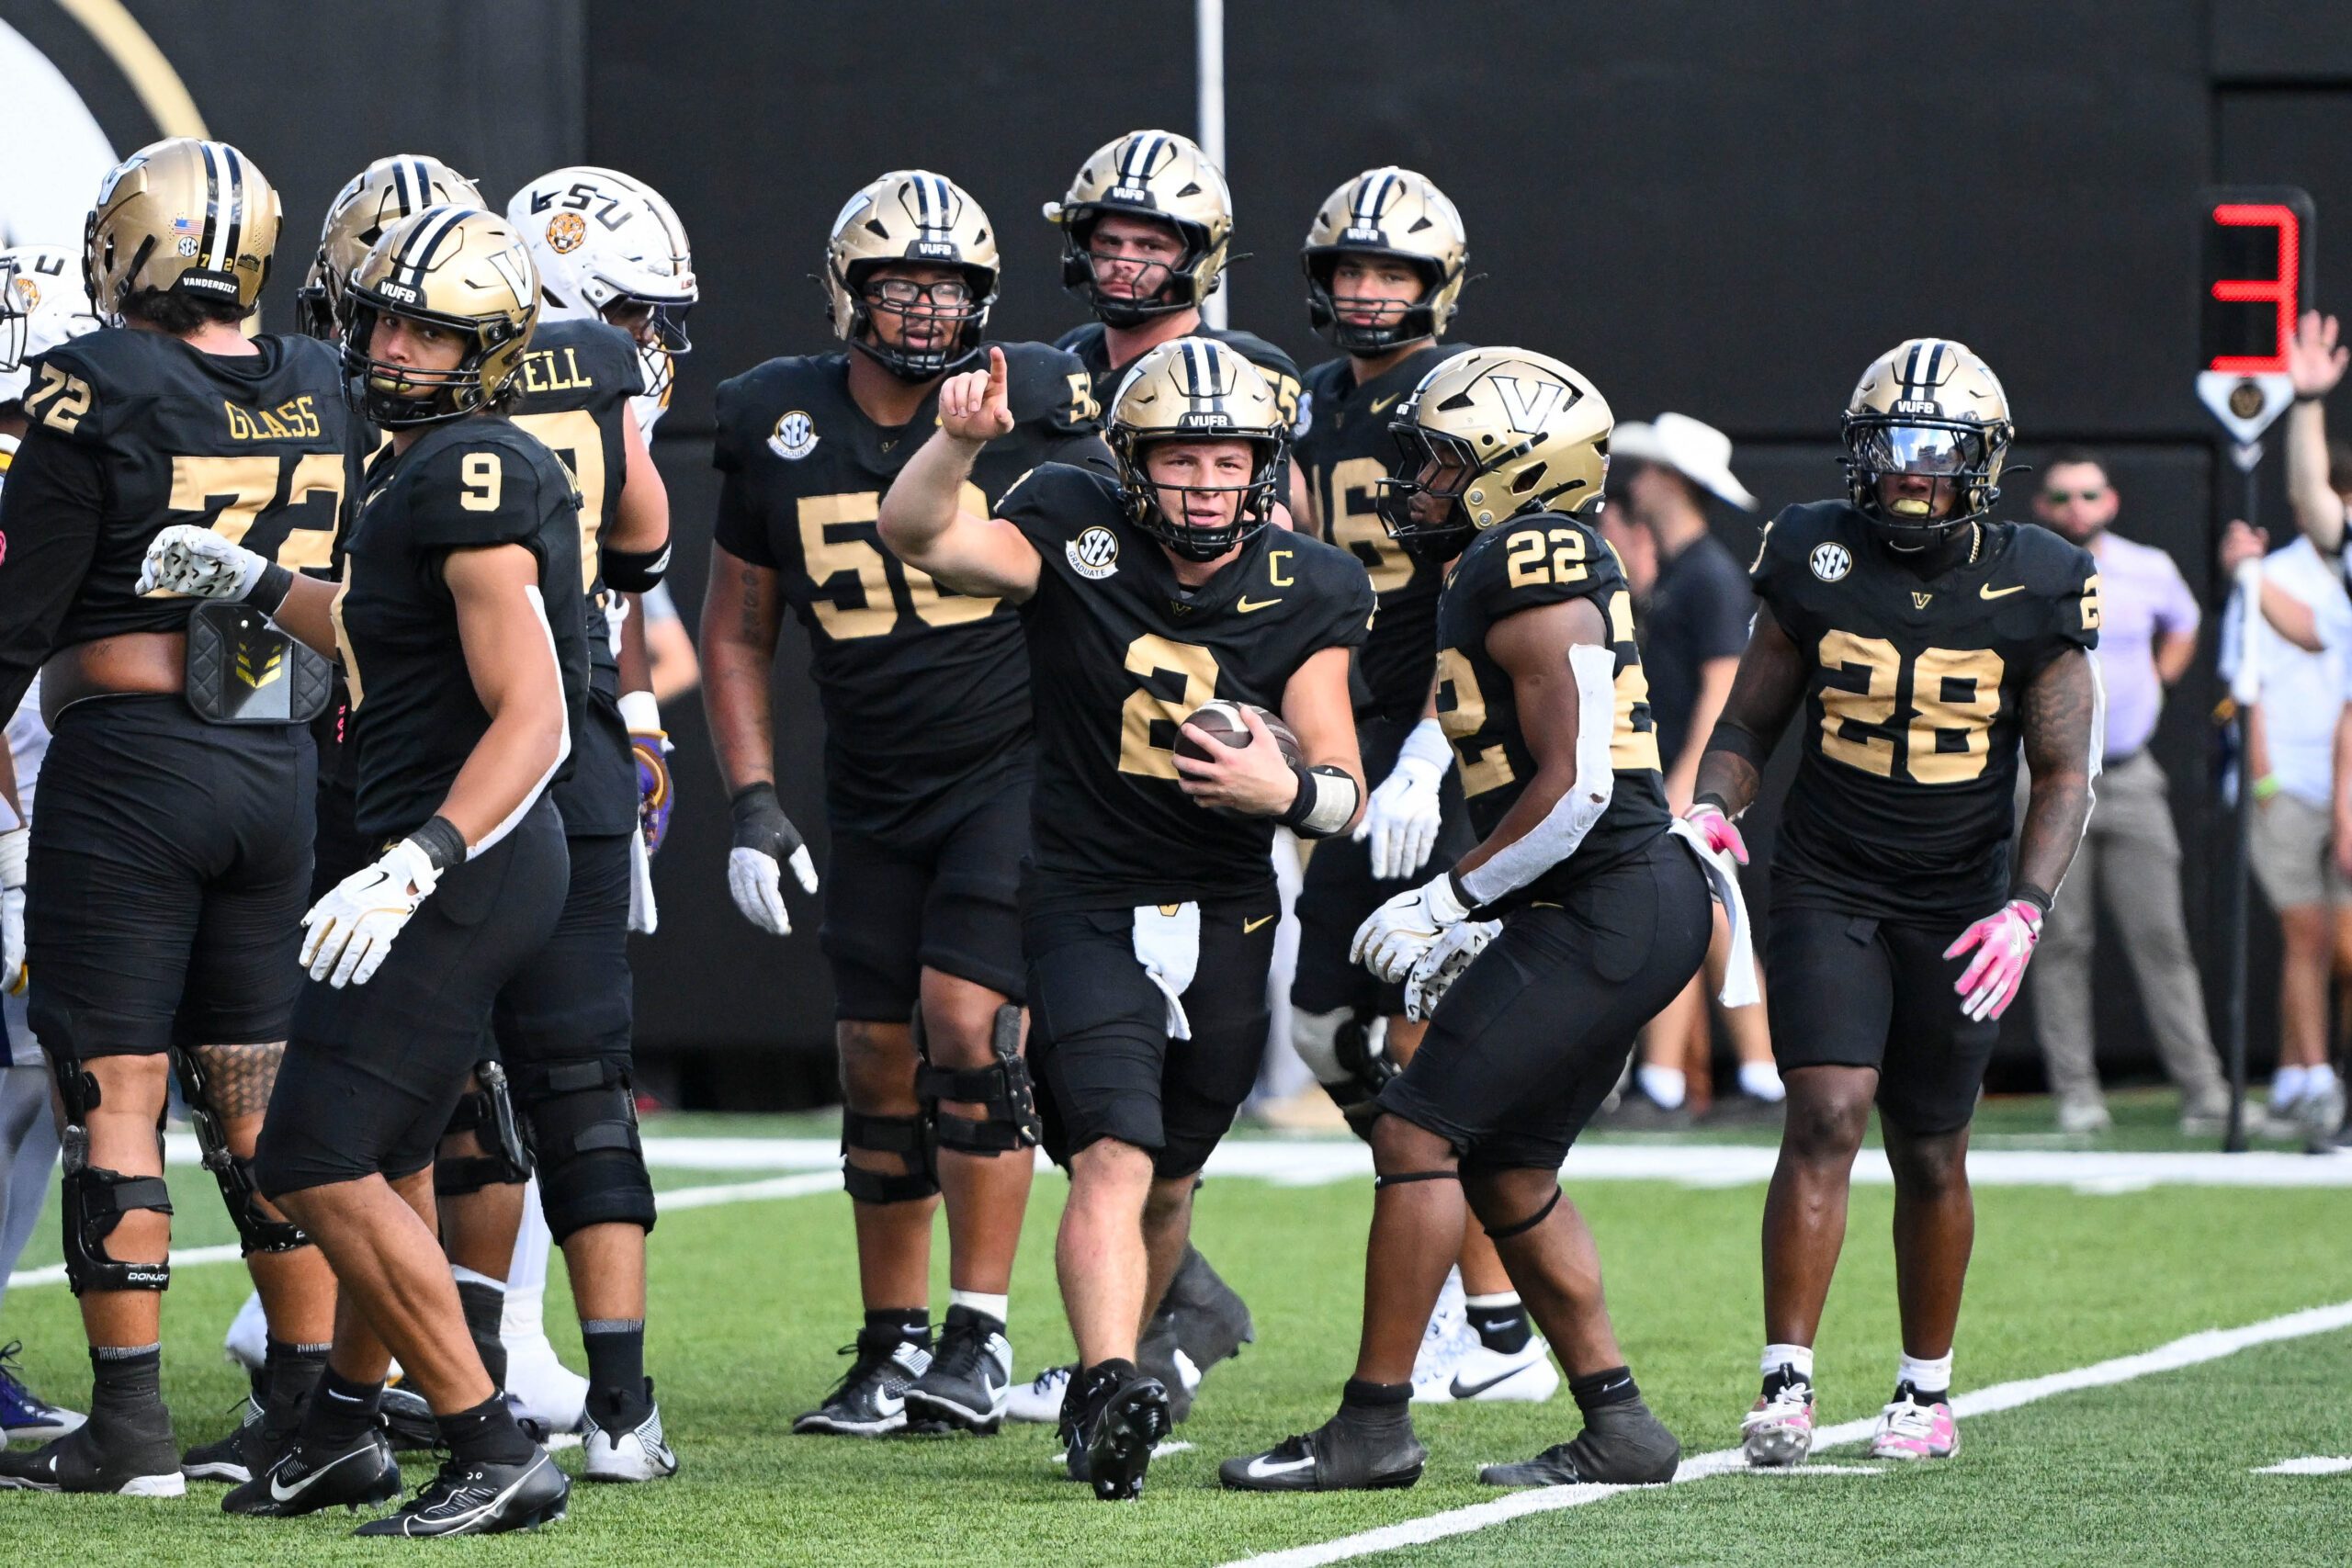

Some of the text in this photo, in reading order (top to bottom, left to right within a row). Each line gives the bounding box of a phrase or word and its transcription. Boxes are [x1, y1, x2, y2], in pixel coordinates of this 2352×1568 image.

[179, 236, 198, 257] SEC
[919, 243, 952, 255] VUFB
[183, 276, 238, 294] VANDERBILT
[379, 281, 417, 303] VUFB
[2211, 204, 2299, 375] 3
[24, 361, 92, 434] 72
[1897, 400, 1935, 414] VUFB
[224, 396, 321, 440] GLASS
[780, 413, 811, 447] SEC
[1188, 414, 1228, 426] VUFB
[460, 452, 502, 512] 9
[136, 454, 345, 599] 72
[1068, 550, 1108, 578] GRADUATE
[1079, 529, 1116, 567] SEC
[1506, 528, 1589, 589] 22
[1813, 546, 1850, 581] SEC
[1270, 550, 1295, 587] C
[1118, 633, 1219, 780] 2
[1818, 629, 2005, 784] 28
[128, 1271, 169, 1281] DONJOY
